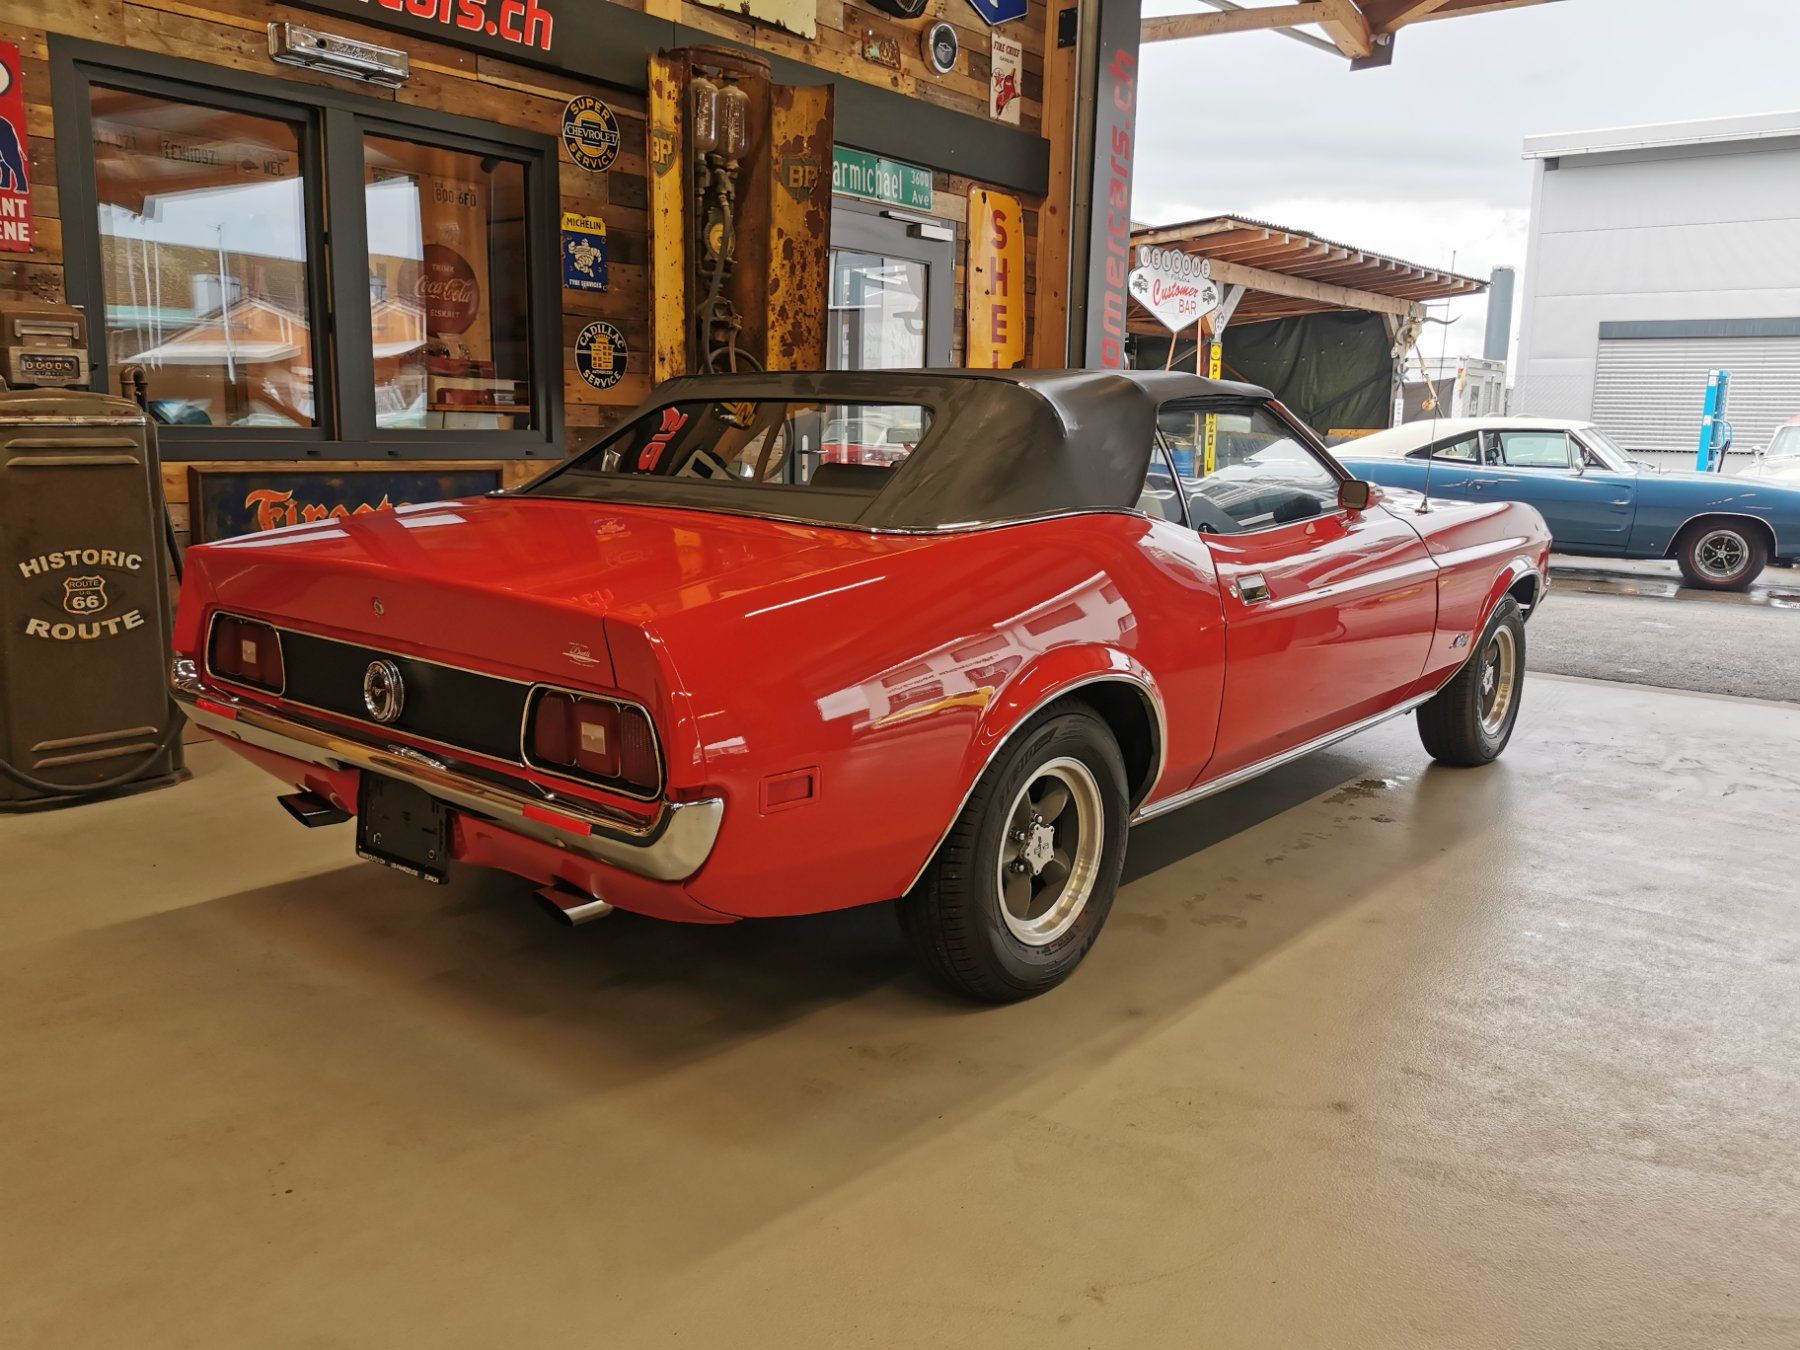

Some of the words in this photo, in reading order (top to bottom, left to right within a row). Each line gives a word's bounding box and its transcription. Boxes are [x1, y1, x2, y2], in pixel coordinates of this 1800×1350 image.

[570, 98, 610, 120] SUPER
[566, 125, 616, 142] CHEVROLET
[569, 143, 614, 168] SERVICE
[652, 136, 672, 165] BP
[832, 160, 903, 200] armichael
[911, 170, 930, 188] 3600
[911, 190, 930, 206] Ave
[566, 217, 602, 231] MICHELIN
[1142, 249, 1210, 277] WELCOME
[1152, 278, 1199, 306] Customer
[1178, 299, 1197, 315] BAR
[580, 324, 625, 349] CADILLAC
[582, 369, 622, 388] SERVICE
[18, 549, 143, 578] HISTORIC
[69, 579, 100, 588] ROUTE
[72, 595, 100, 610] 66
[25, 608, 145, 641] ROUTE
